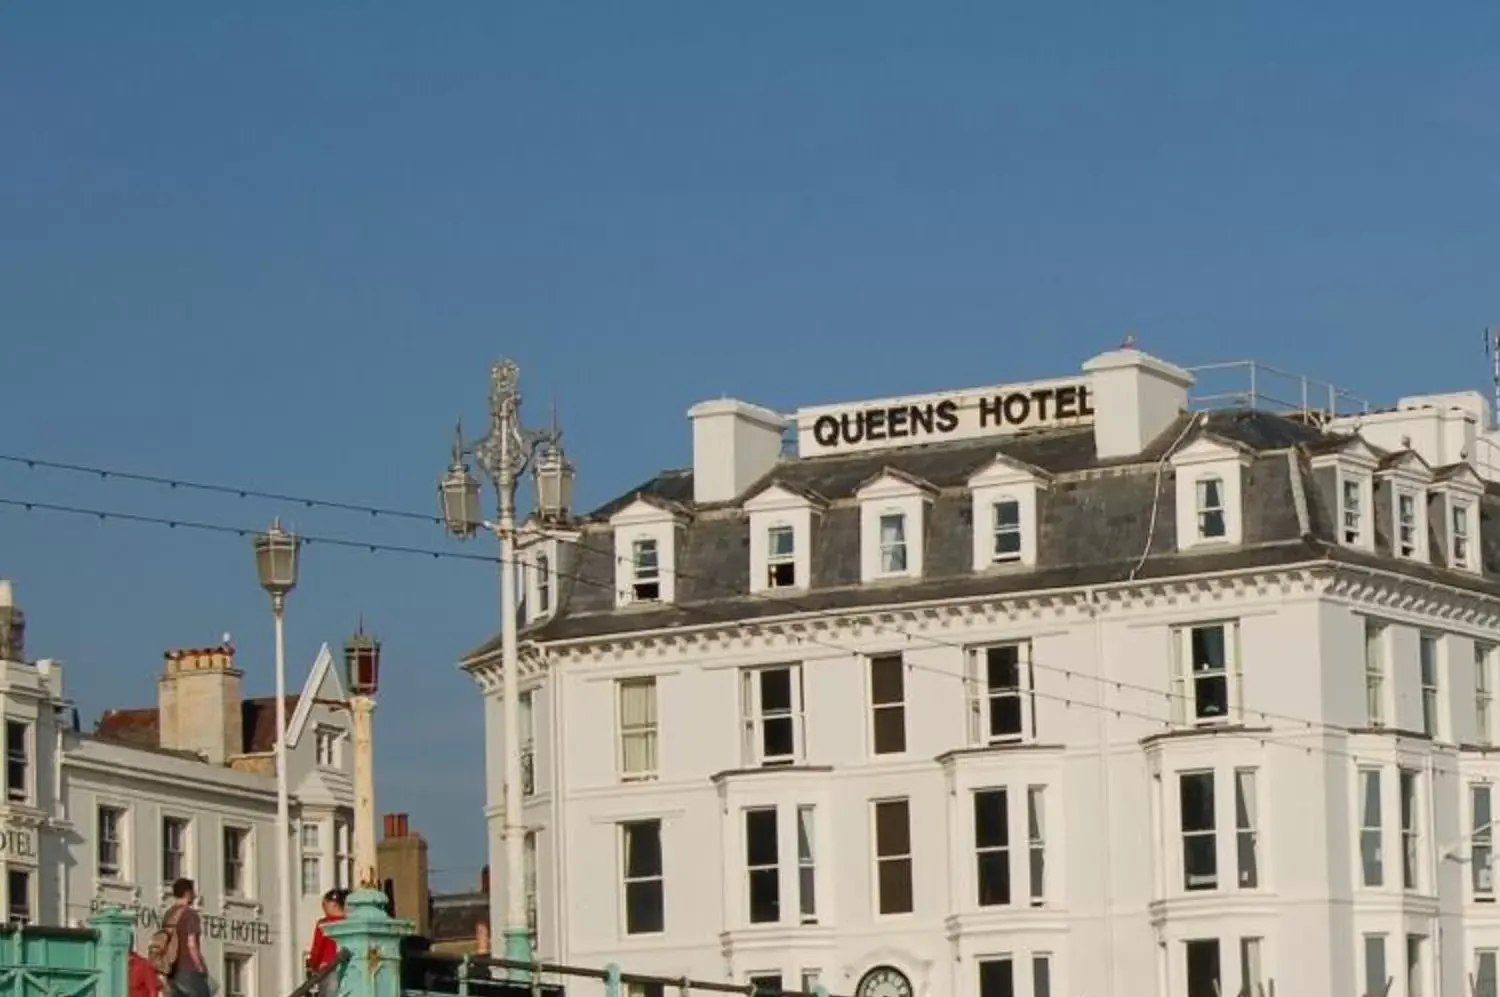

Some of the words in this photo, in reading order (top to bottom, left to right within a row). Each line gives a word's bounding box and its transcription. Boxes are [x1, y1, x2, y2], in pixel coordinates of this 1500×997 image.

[813, 400, 959, 447] QUEENS
[979, 385, 1096, 428] HOTEL
[231, 920, 273, 945] HOTEL
